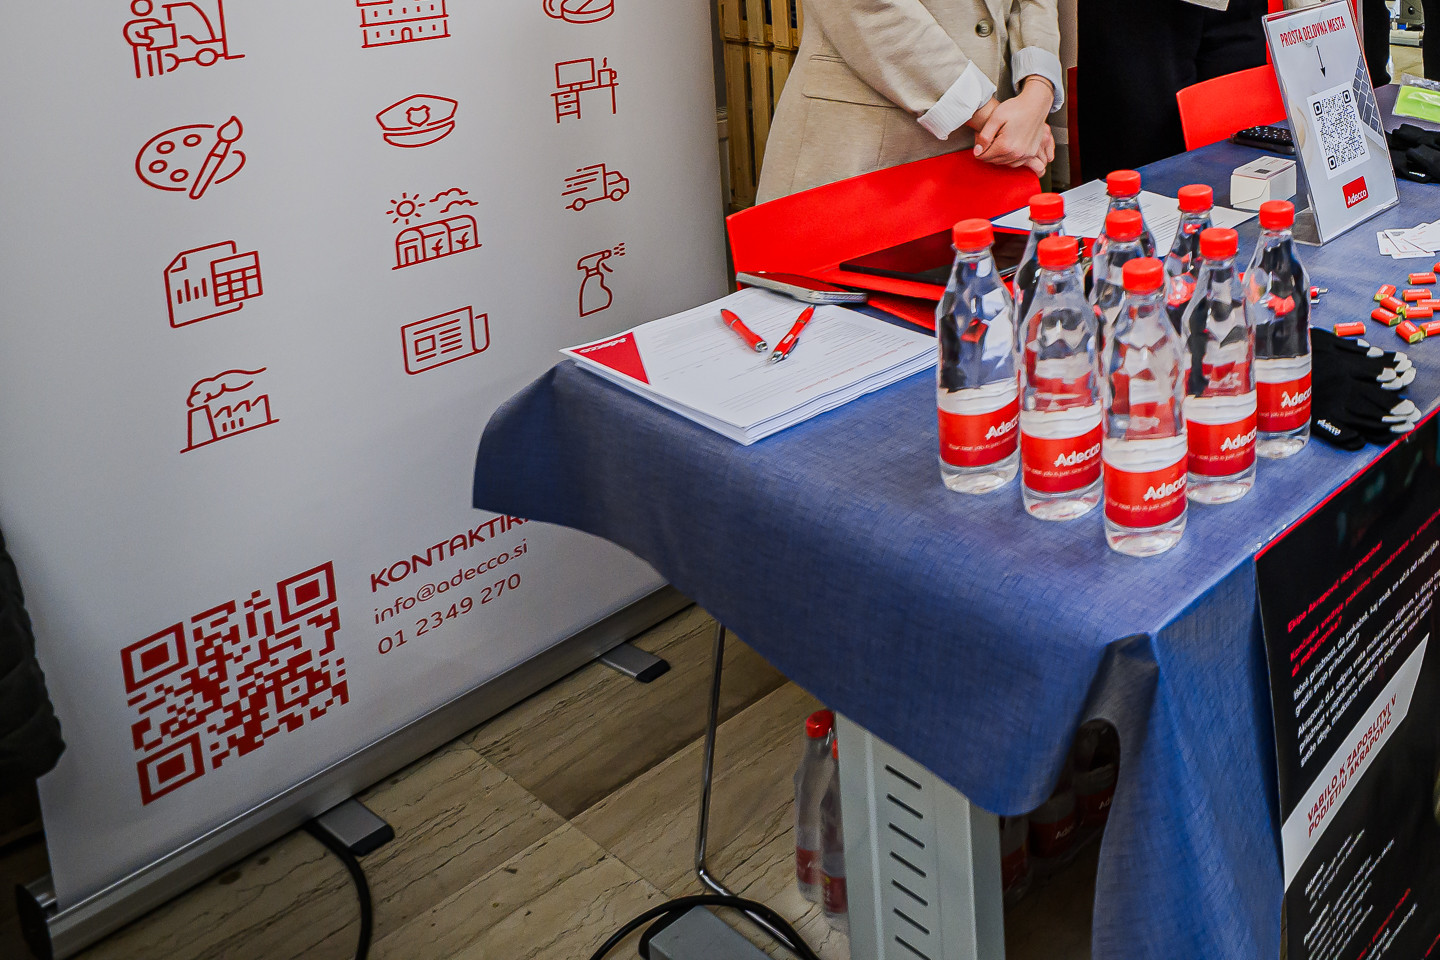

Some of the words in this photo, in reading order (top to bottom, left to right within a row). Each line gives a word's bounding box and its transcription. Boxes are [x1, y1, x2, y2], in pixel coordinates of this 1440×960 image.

[1279, 28, 1304, 48] PROSTA
[1302, 20, 1329, 41] DELOVNA
[1326, 15, 1347, 33] MESTA
[1347, 189, 1367, 206] Adecco
[1281, 385, 1312, 409] Adecc
[985, 412, 1020, 441] Adecc
[1220, 425, 1257, 452] Adecc
[1054, 442, 1100, 468] Adecco
[1142, 472, 1187, 502] Adecc
[370, 514, 529, 592] KONTAKTIR
[374, 538, 528, 625] info@adecco.si
[378, 629, 408, 655] 01
[415, 596, 474, 637] 2349
[481, 573, 521, 605] 270
[1307, 774, 1338, 822] VABILO
[1339, 762, 1346, 777] K
[1346, 701, 1391, 769] ZAPOSLITVI
[1391, 693, 1397, 708] V
[1308, 777, 1347, 838] PODJETJU
